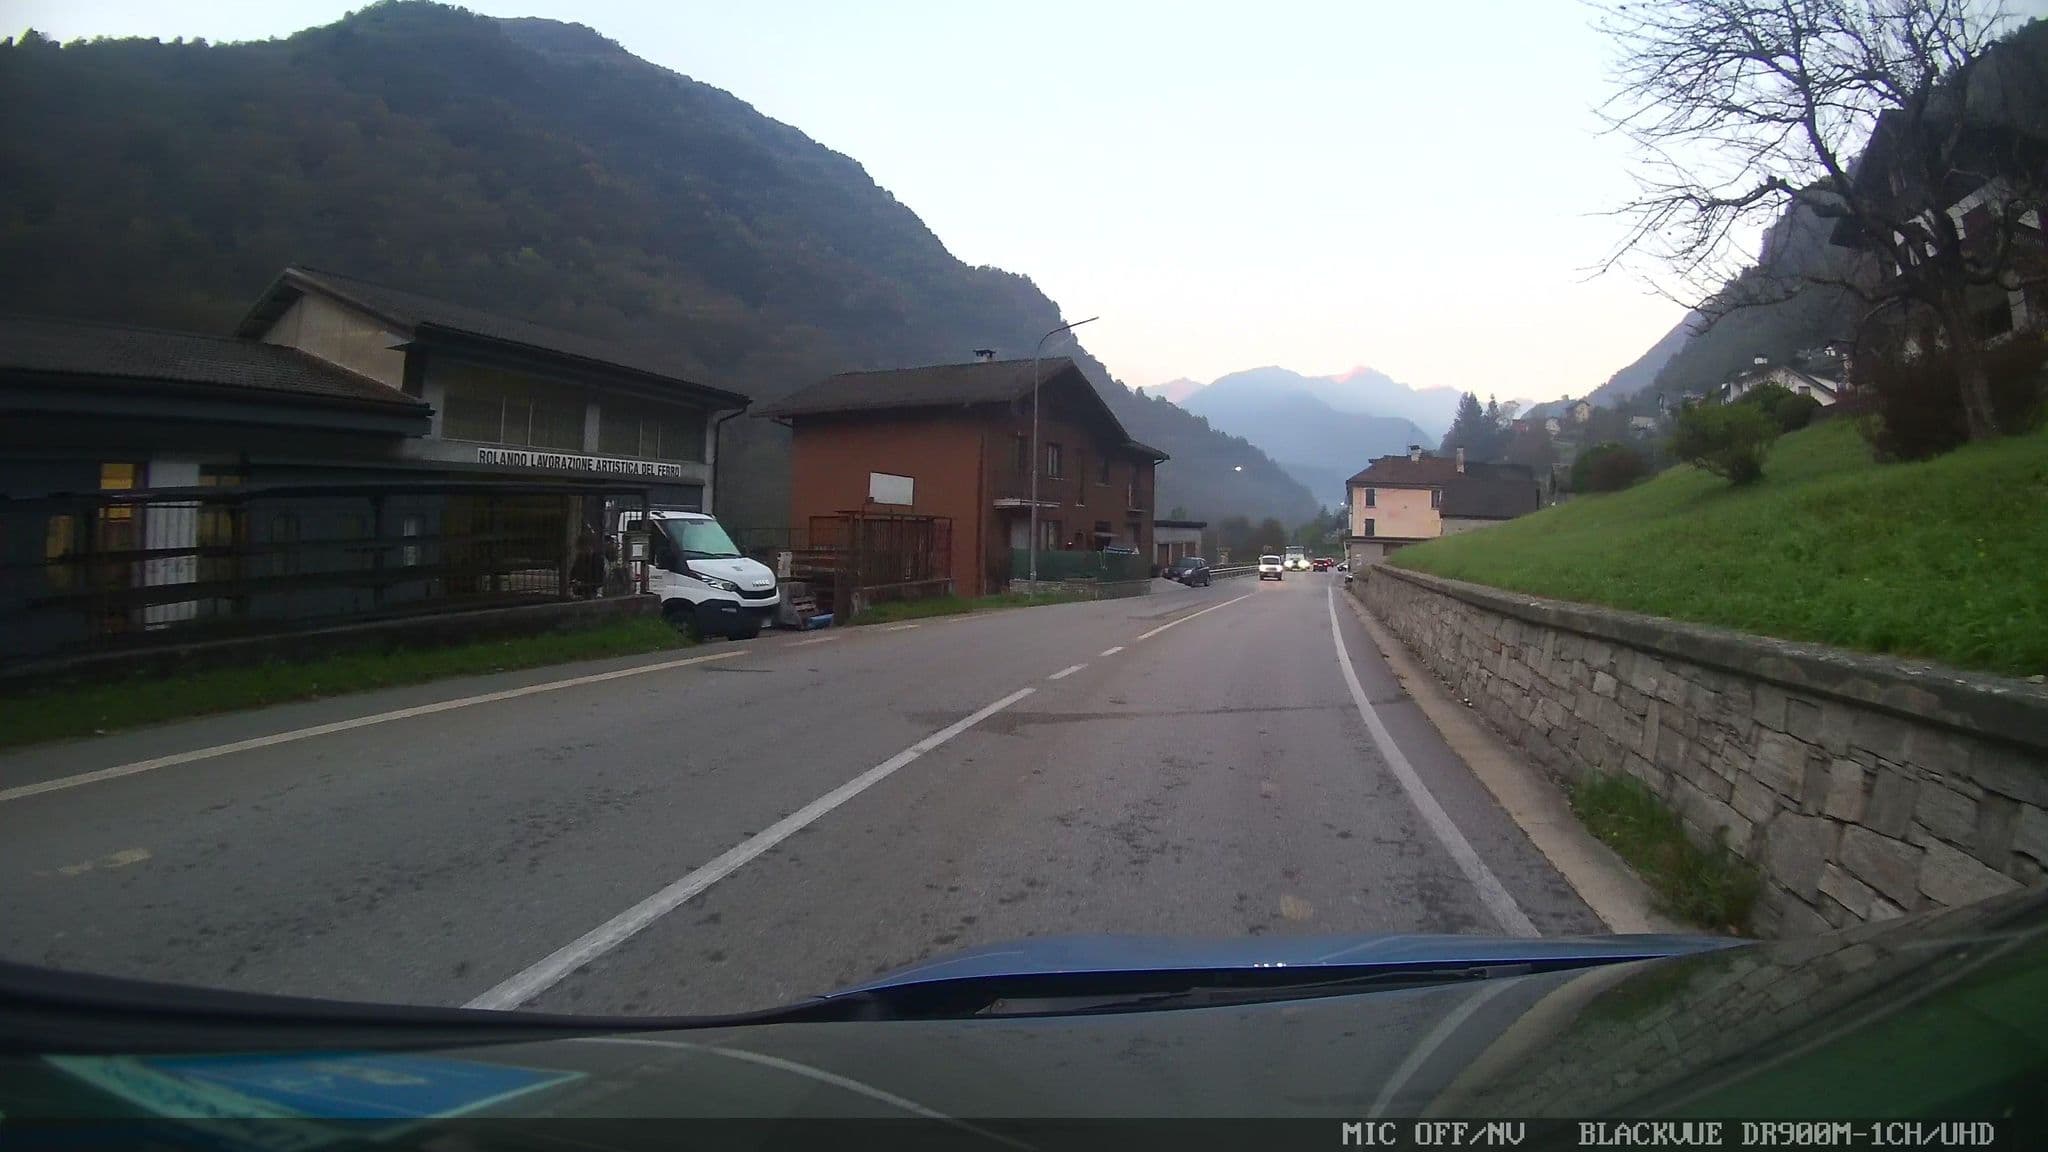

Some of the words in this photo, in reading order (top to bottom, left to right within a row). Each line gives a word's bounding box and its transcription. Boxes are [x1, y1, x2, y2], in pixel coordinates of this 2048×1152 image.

[479, 450, 527, 465] ROLANDO
[531, 453, 593, 471] LAVORAZIONE
[595, 459, 639, 475] ARTISTICA
[642, 463, 656, 476] DEL
[658, 465, 680, 478] FERRO
